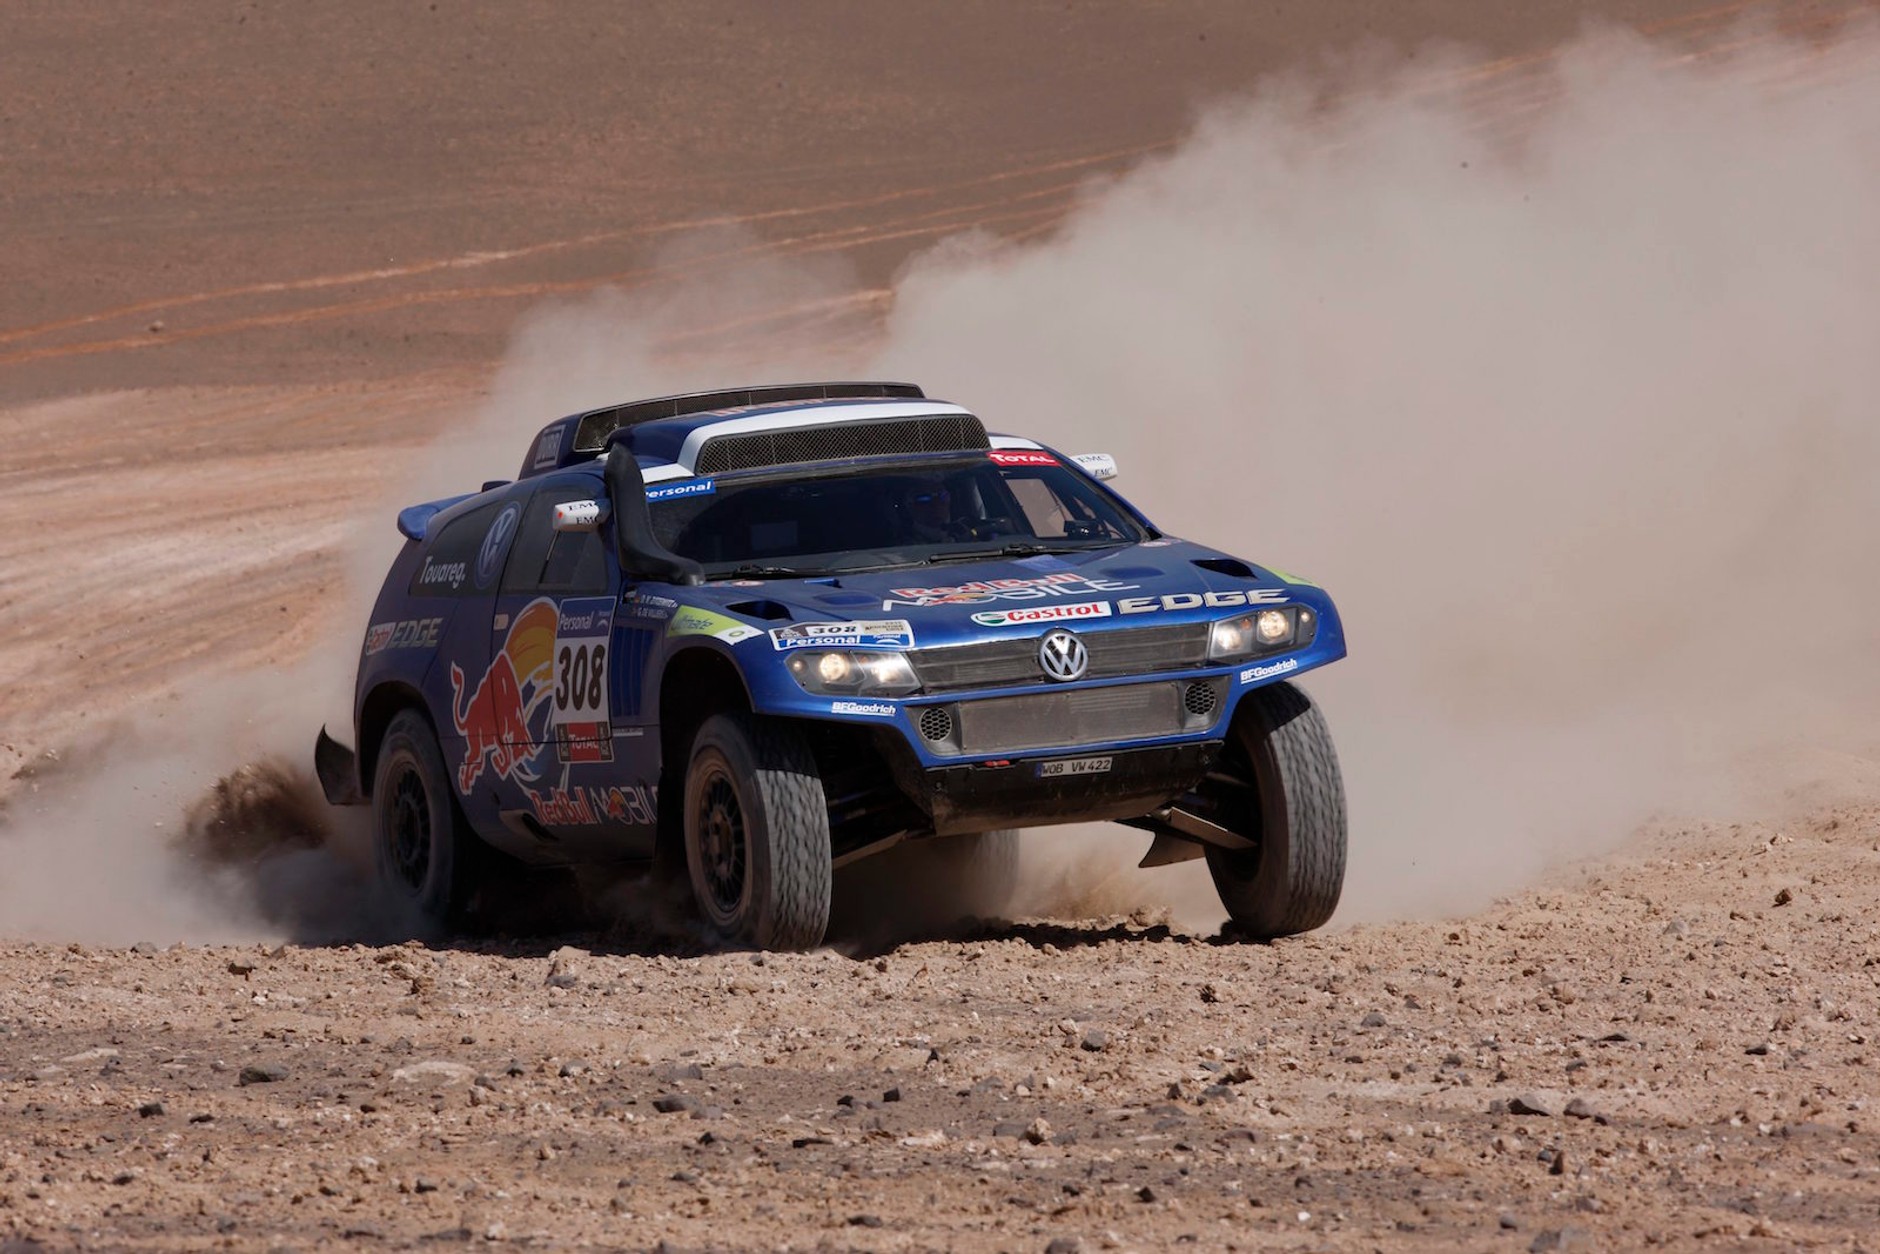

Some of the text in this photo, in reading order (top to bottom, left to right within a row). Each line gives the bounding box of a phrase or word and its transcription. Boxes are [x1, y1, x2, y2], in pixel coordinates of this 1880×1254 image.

[989, 453, 1056, 463] TOTAL
[645, 481, 711, 498] ersonal
[1006, 600, 1104, 622] Castrol
[1116, 588, 1290, 615] EDGE
[560, 610, 594, 631] Personal
[814, 625, 857, 634] 308
[387, 617, 444, 649] EDGE
[786, 635, 860, 647] Personal
[555, 644, 606, 711] 308
[1239, 658, 1298, 683] BFGoodrich
[831, 700, 897, 714] BFGoodrich
[1043, 759, 1111, 775] WOB VW 422
